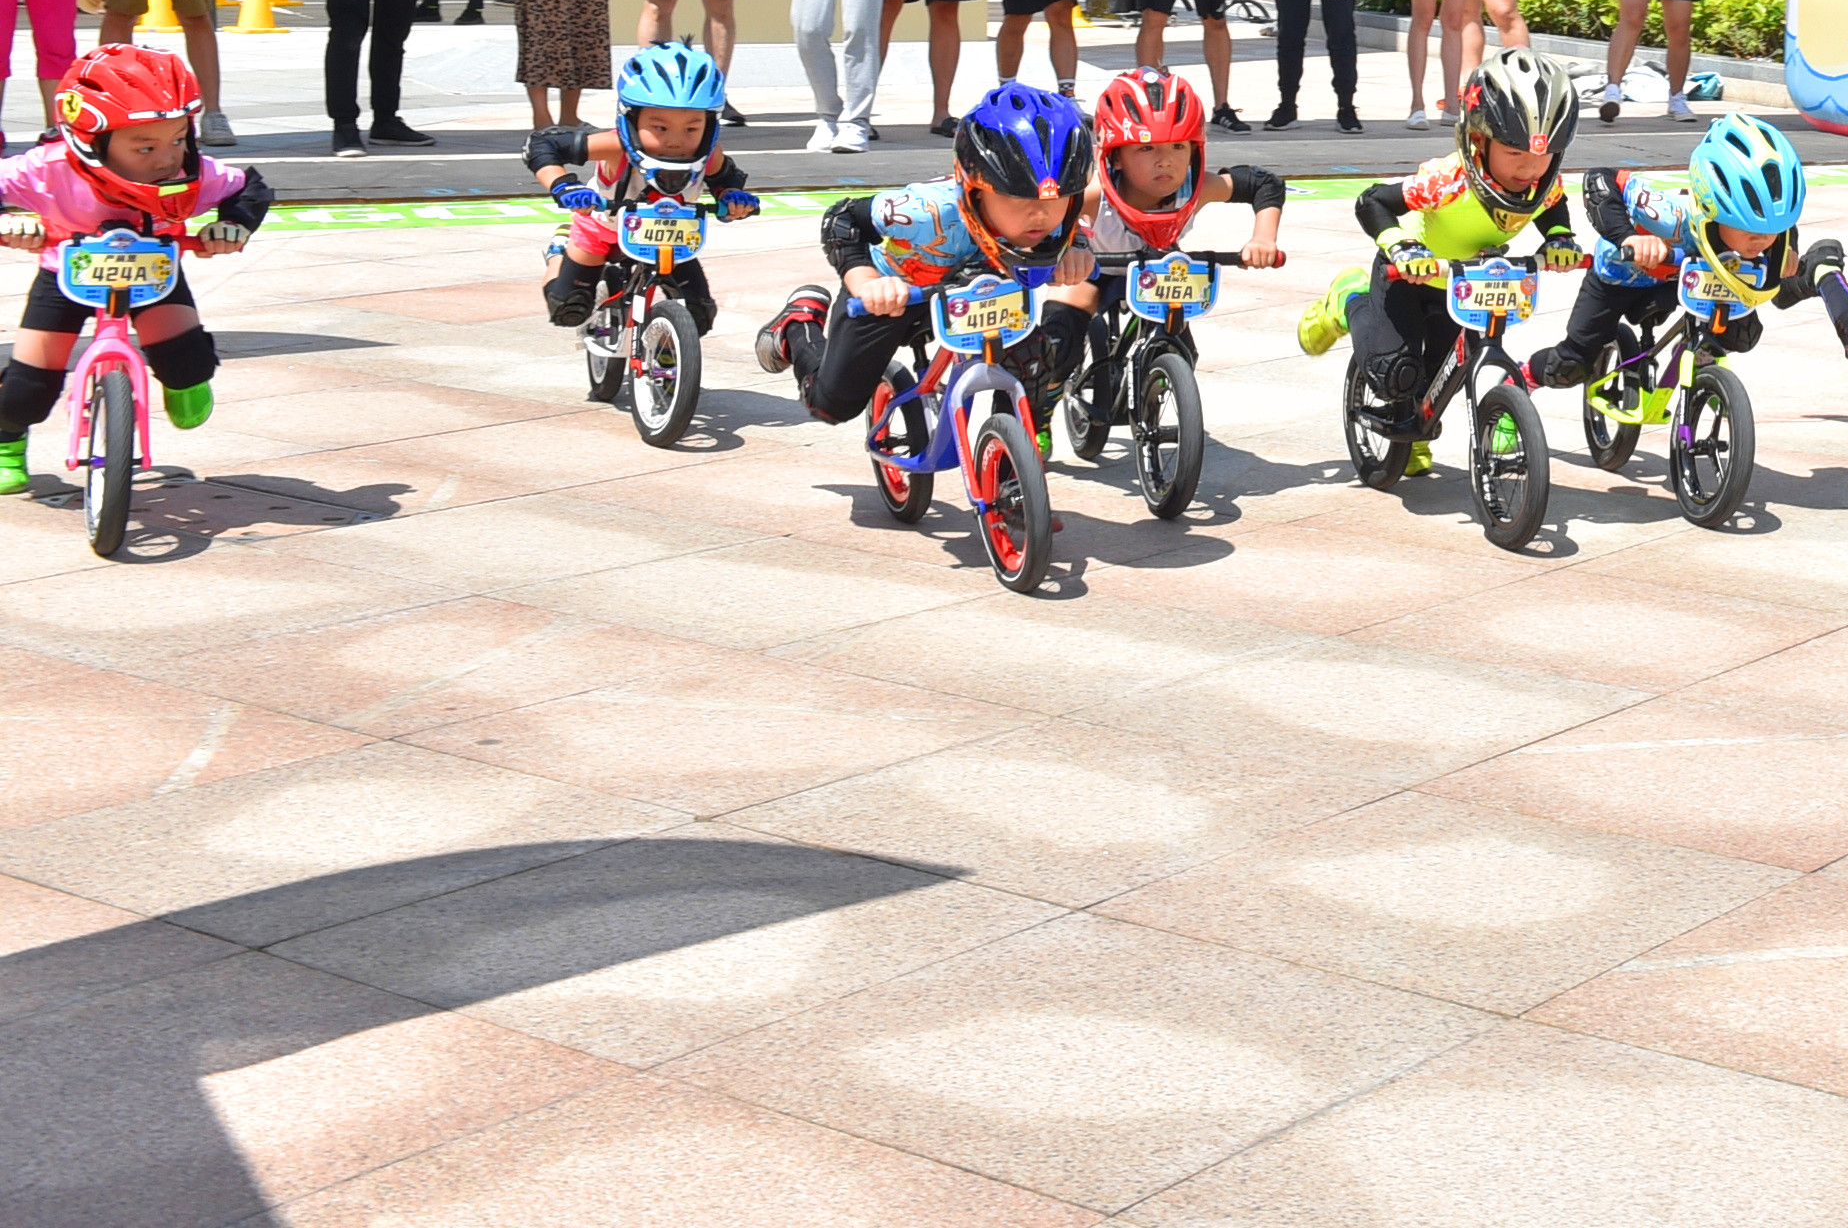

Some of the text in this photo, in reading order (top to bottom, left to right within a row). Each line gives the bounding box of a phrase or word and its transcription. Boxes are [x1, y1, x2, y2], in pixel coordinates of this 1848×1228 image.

[644, 229, 684, 243] 407A
[92, 266, 147, 282] 424A
[1155, 285, 1192, 299] 416A
[1474, 292, 1517, 307] 428A
